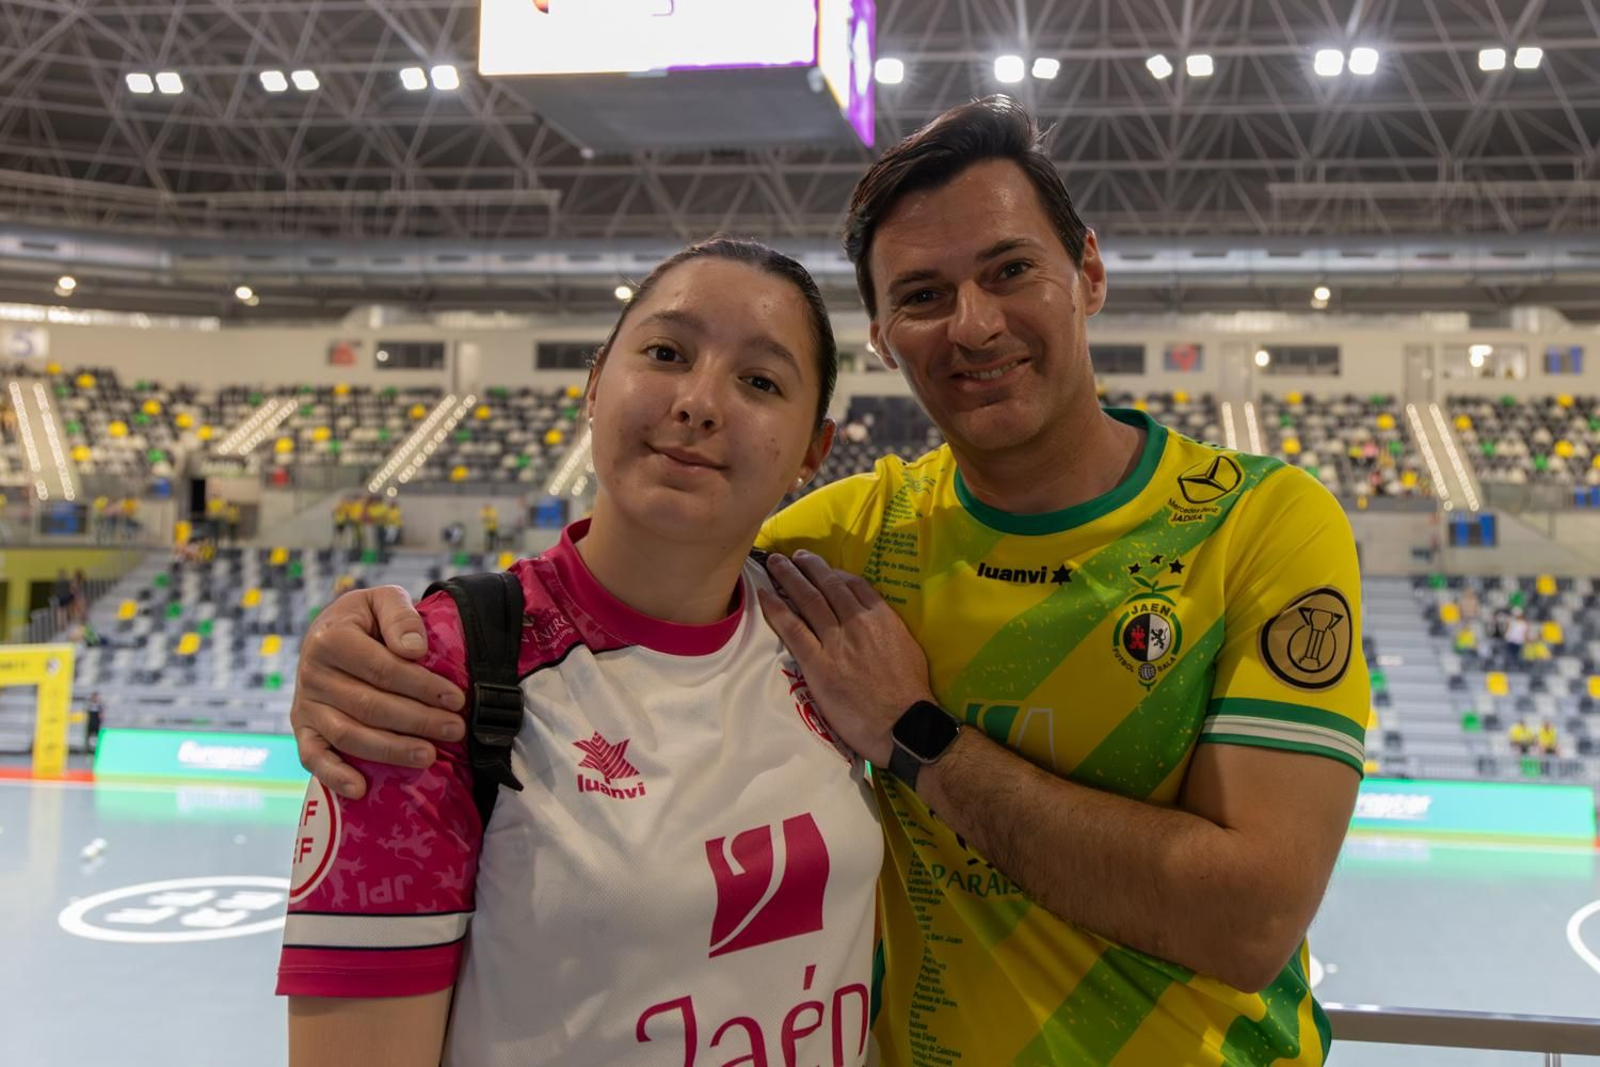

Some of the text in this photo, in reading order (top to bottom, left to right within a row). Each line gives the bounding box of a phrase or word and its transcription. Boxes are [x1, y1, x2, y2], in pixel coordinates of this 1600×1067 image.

[977, 562, 1047, 584] luanvi
[1131, 603, 1171, 616] JAEN
[1158, 656, 1176, 672] SALA
[577, 774, 646, 800] luanvi
